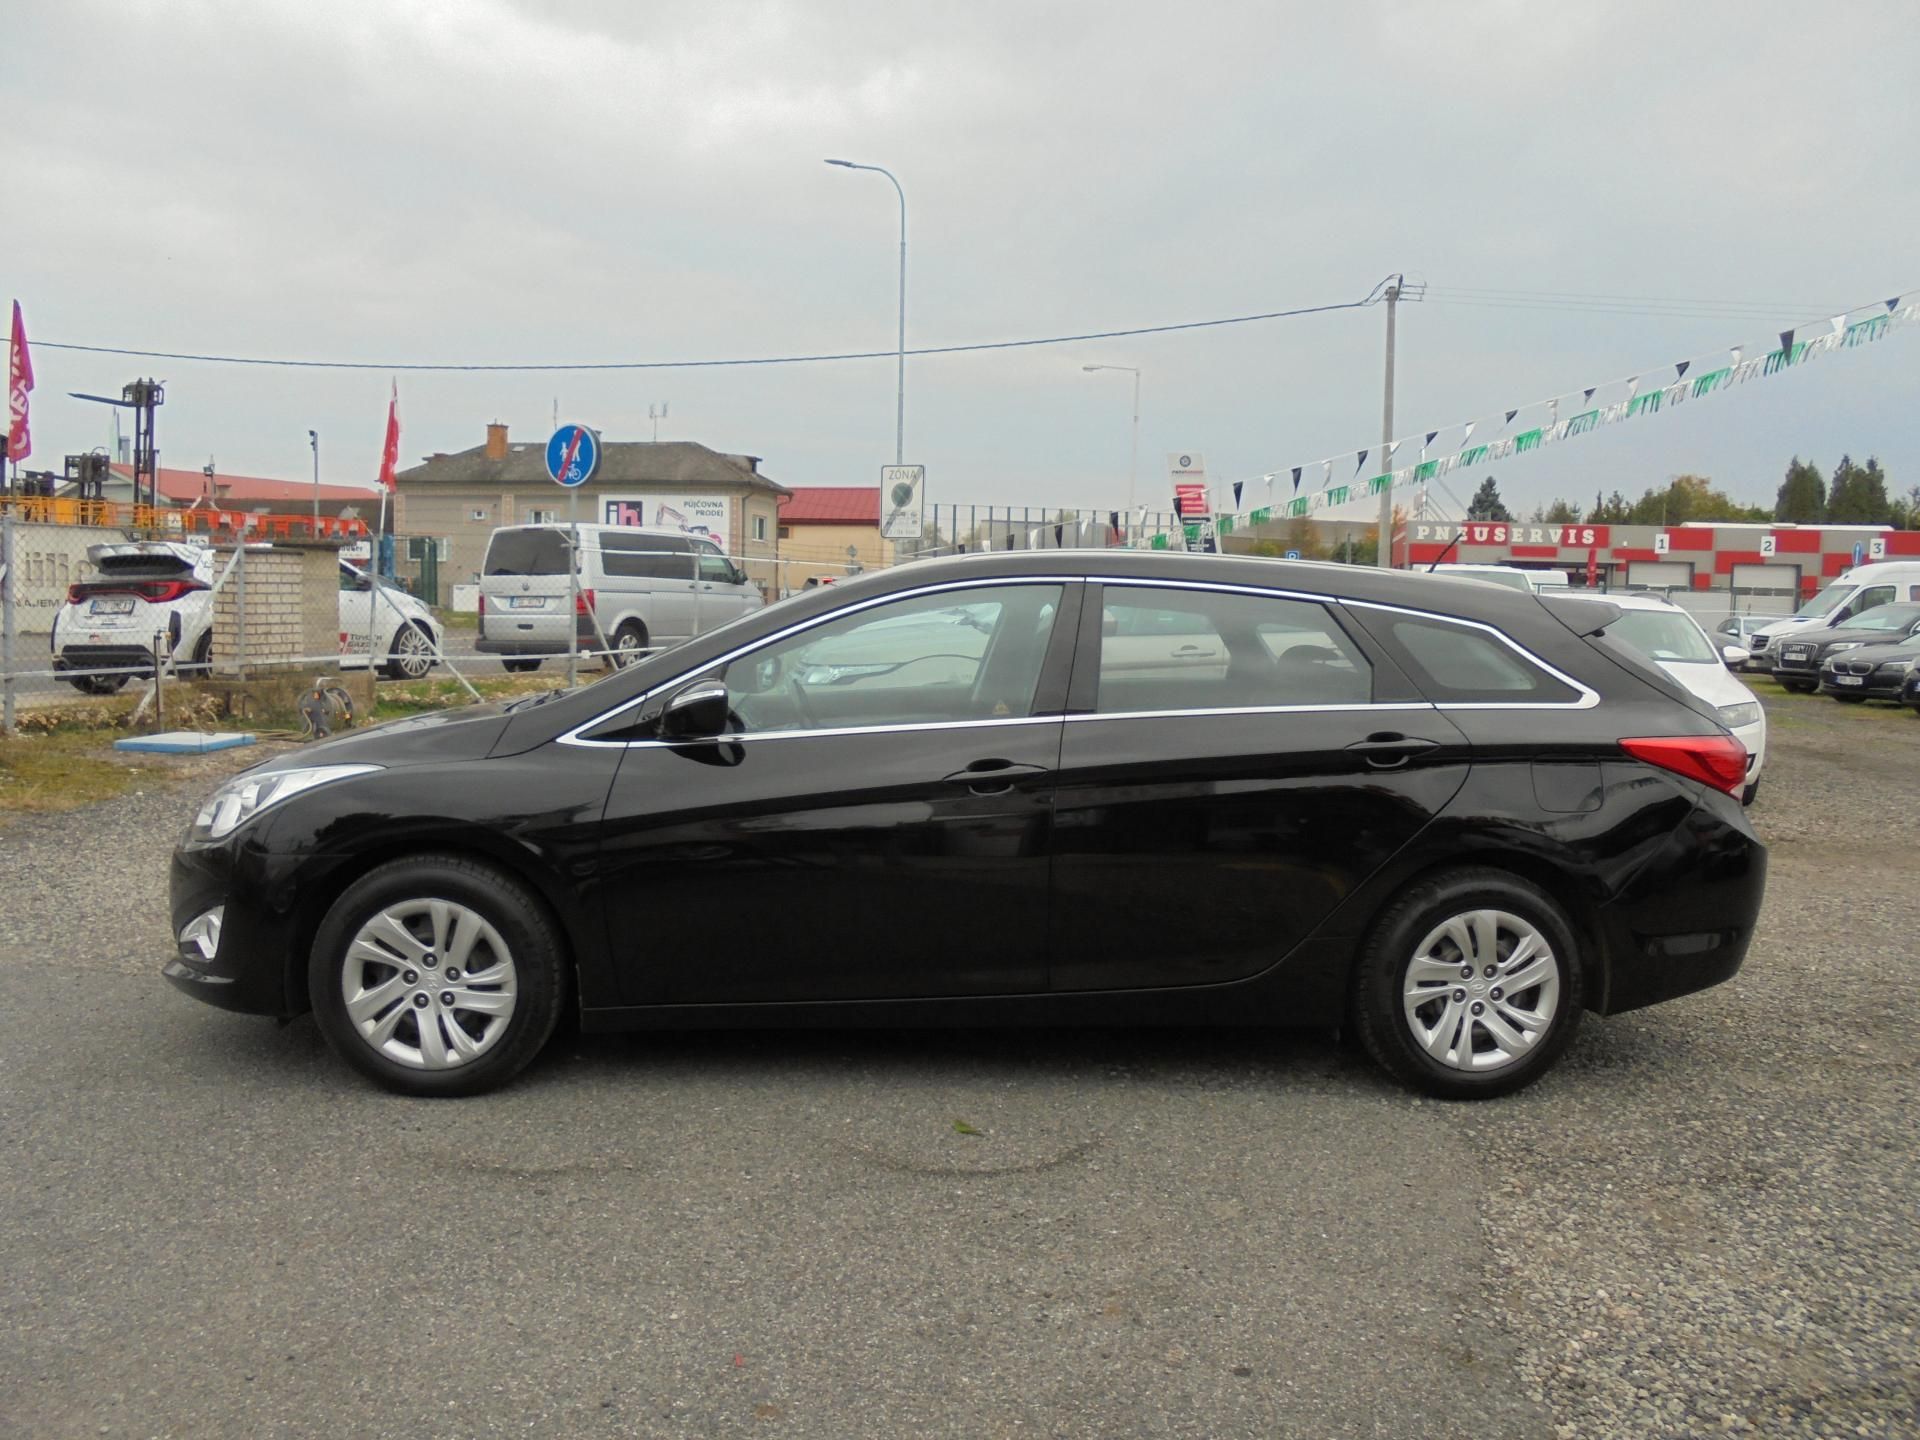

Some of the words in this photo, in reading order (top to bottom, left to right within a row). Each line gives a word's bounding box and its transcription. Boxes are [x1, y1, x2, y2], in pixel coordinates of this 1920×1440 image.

[695, 510, 724, 518] PRODEJ
[1416, 525, 1595, 546] PNEUSERVIS
[1657, 538, 1666, 549] 1
[1763, 540, 1773, 552] 2
[1872, 542, 1882, 554] 3
